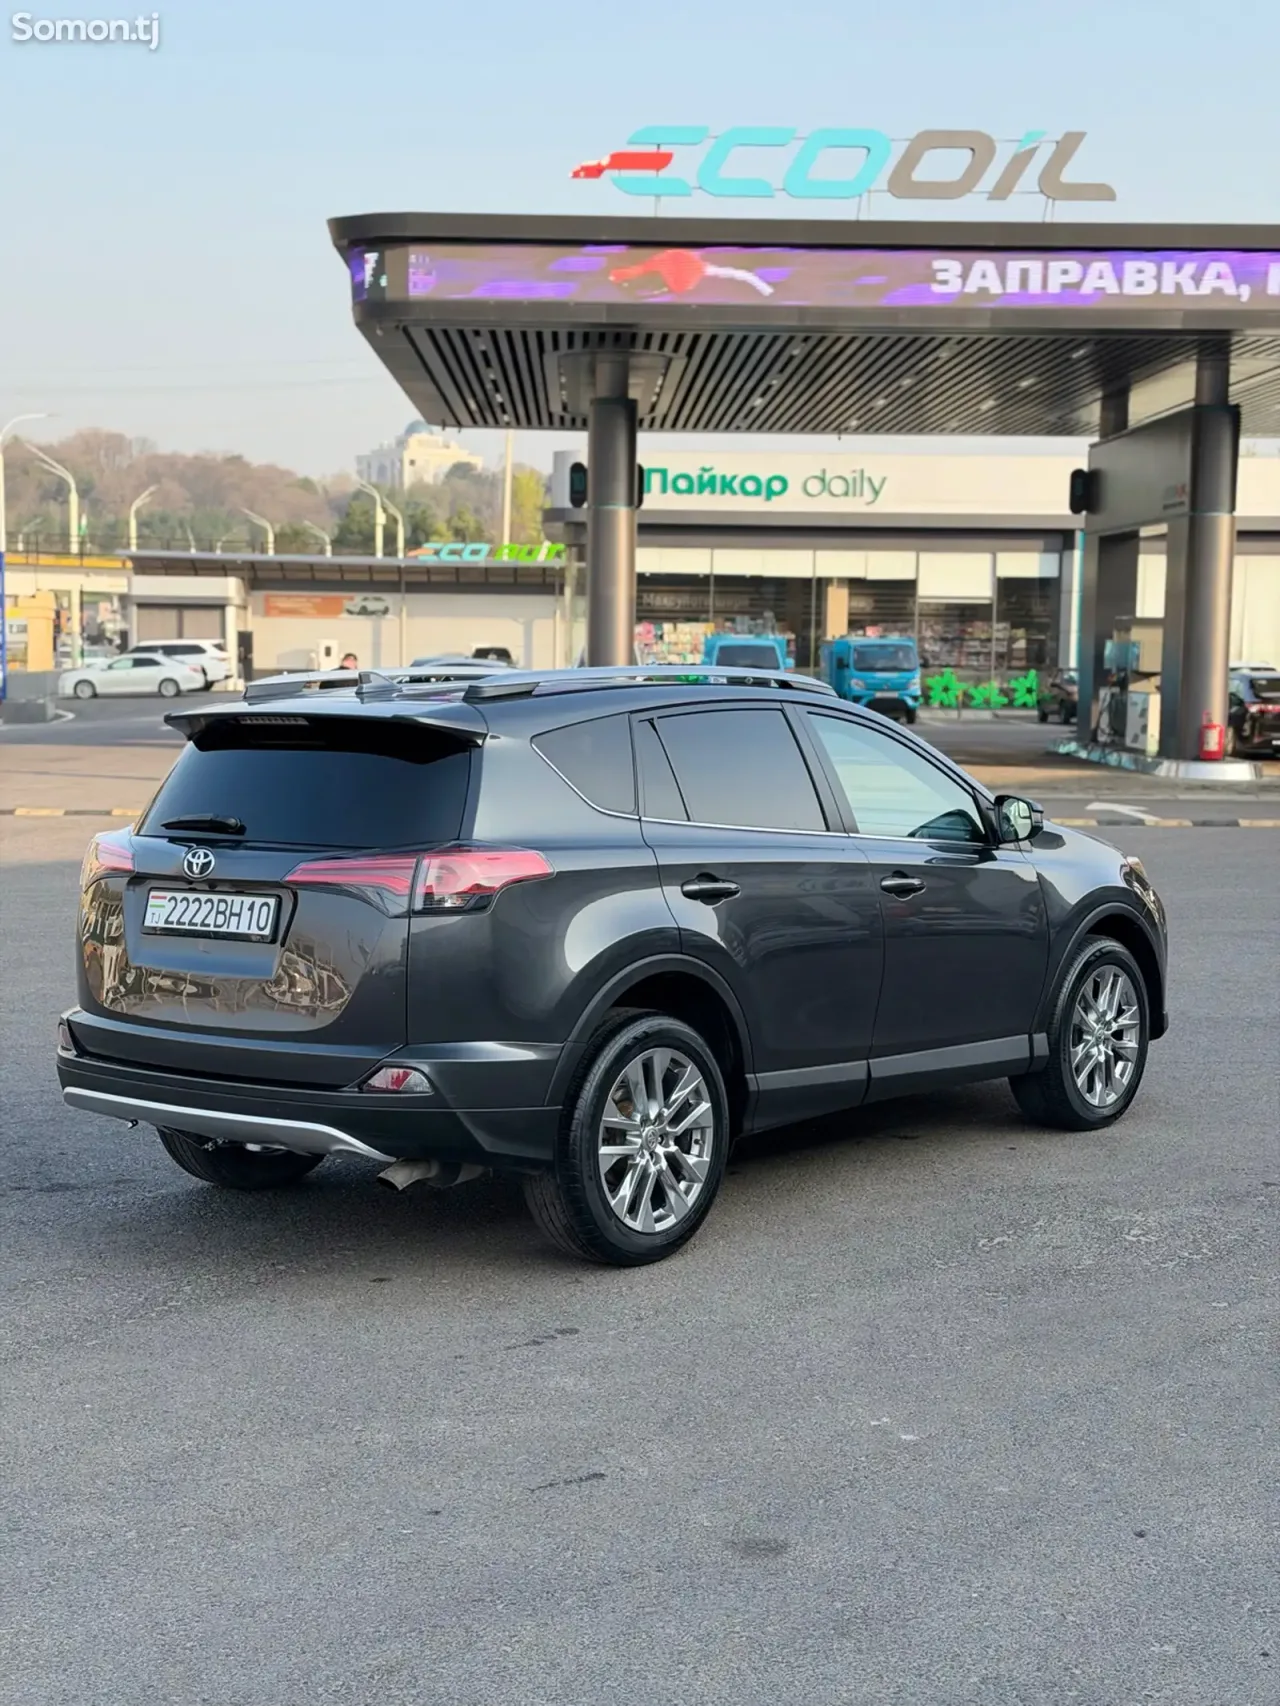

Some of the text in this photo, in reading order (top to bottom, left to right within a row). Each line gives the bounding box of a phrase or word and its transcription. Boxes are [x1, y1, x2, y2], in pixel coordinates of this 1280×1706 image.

[930, 259, 1251, 302] ЗАПРАВКА,
[643, 466, 887, 506] Пайкар daily
[407, 542, 490, 562] ECO
